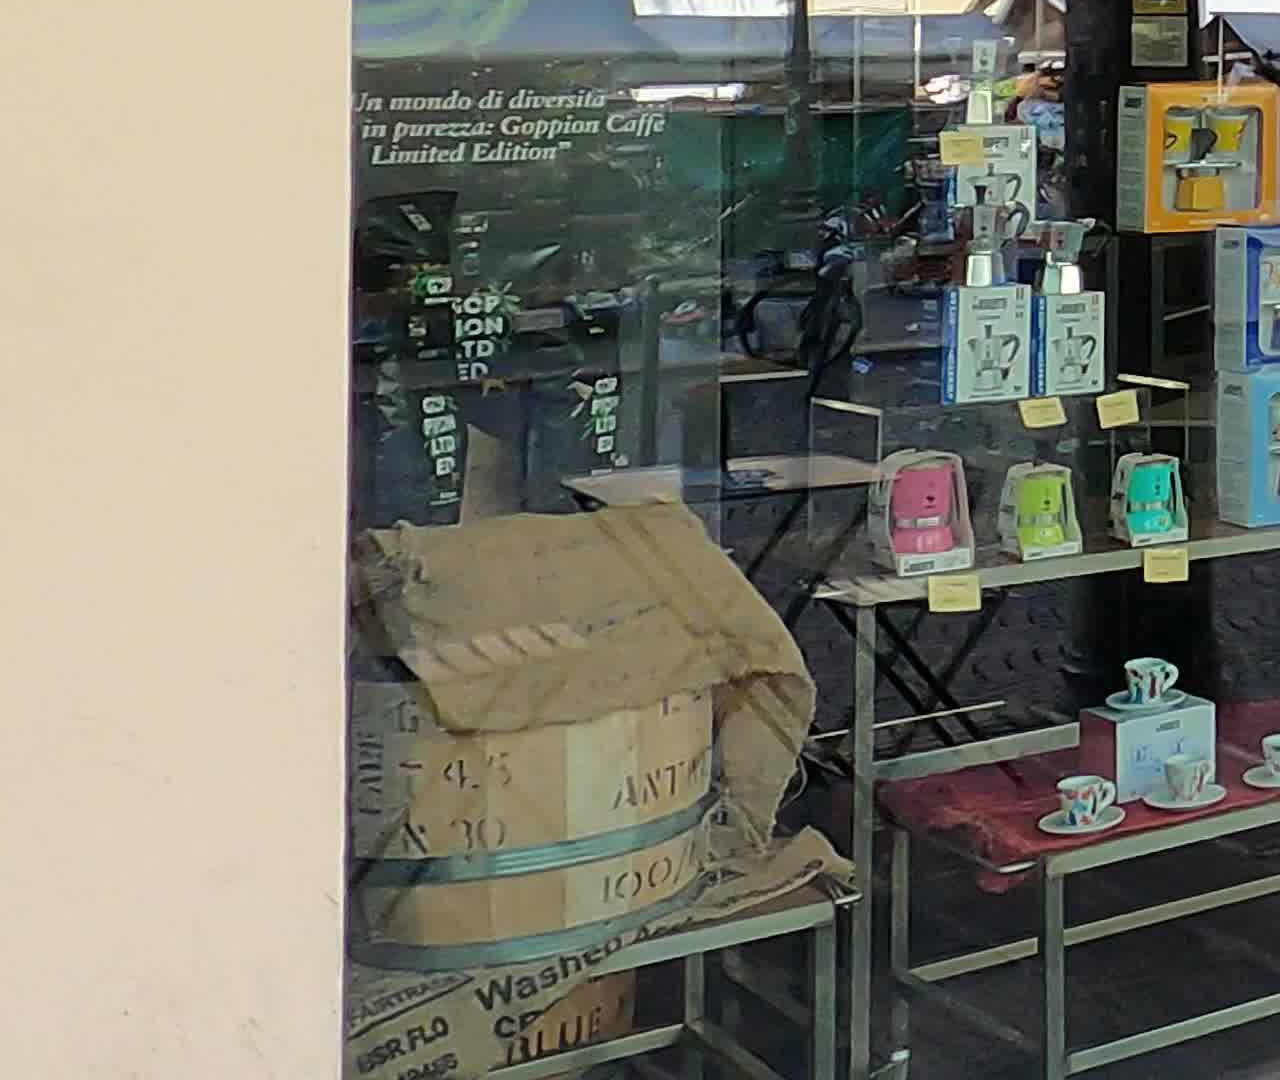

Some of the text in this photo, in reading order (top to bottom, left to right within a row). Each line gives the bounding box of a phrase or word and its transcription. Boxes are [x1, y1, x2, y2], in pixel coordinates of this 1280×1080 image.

[389, 90, 472, 111] mondo
[478, 89, 504, 110] di
[362, 119, 388, 139] in
[392, 120, 496, 143] purezza:
[500, 115, 601, 140] Goppion
[371, 142, 467, 165] Limited
